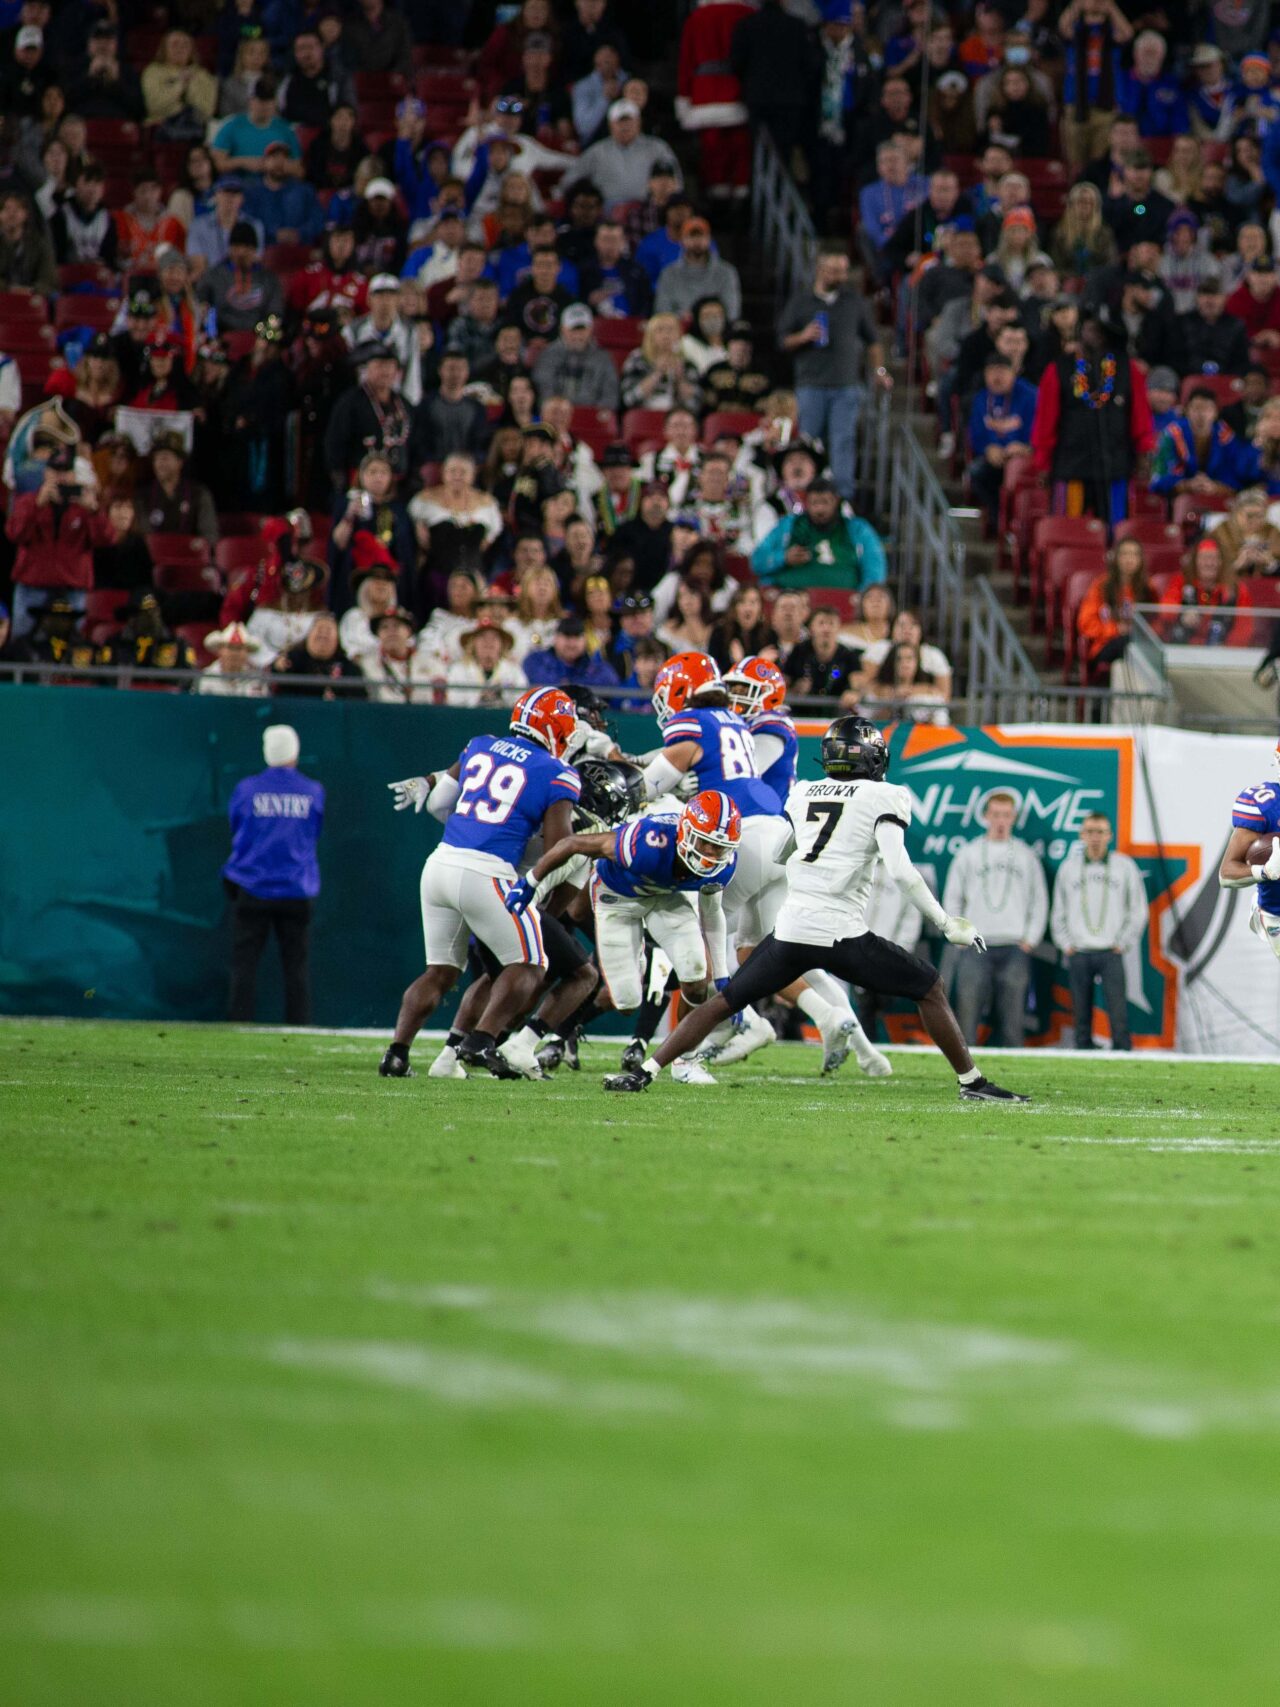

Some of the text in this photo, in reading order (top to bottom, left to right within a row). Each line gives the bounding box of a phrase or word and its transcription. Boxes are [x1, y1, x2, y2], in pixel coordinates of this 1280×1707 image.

[489, 740, 532, 763] RICKS
[455, 752, 527, 825] 29
[804, 785, 861, 799] BROWN
[252, 792, 314, 819] SENTRY
[801, 801, 845, 864] 7
